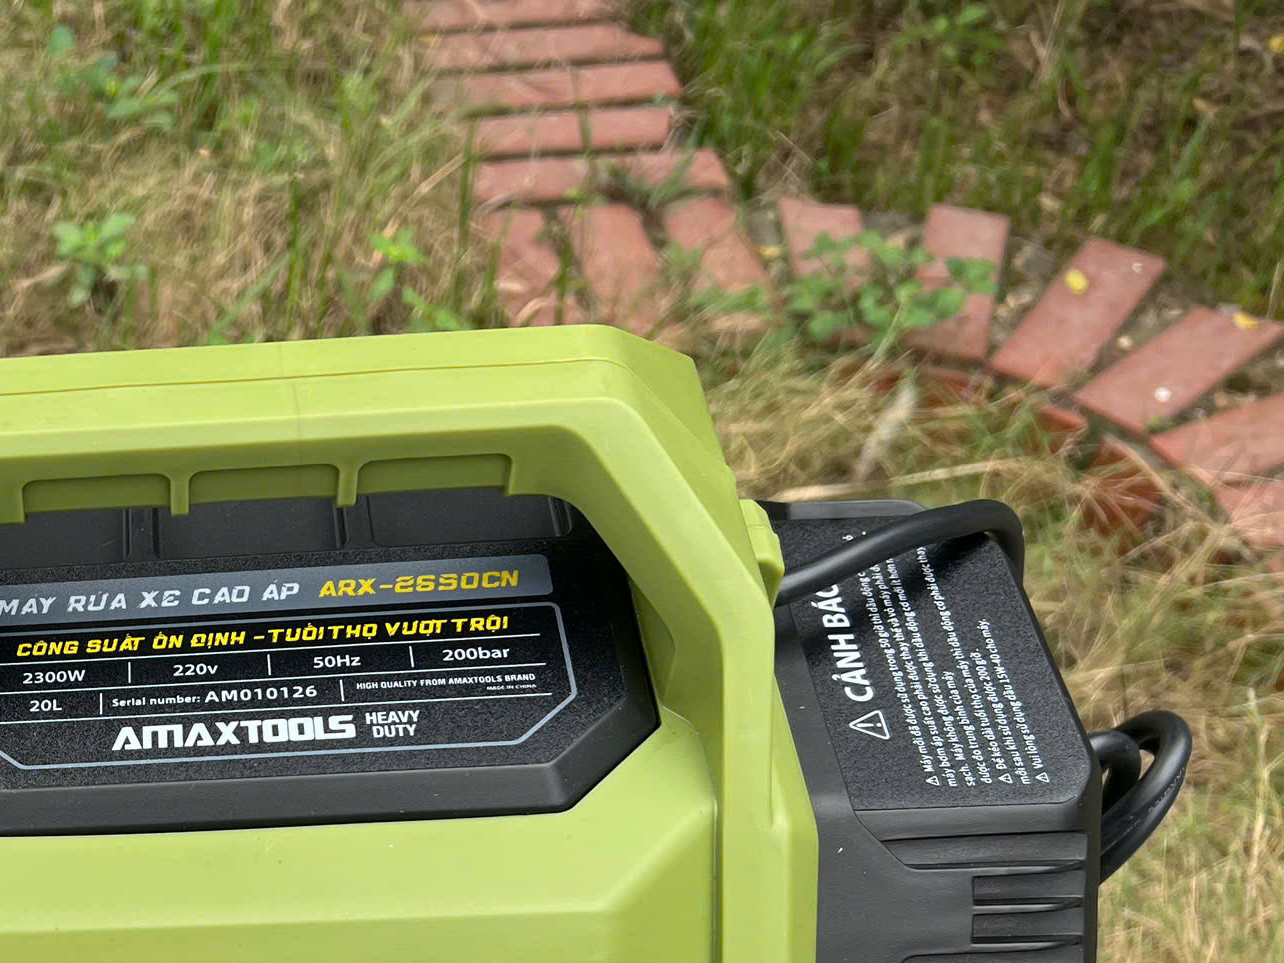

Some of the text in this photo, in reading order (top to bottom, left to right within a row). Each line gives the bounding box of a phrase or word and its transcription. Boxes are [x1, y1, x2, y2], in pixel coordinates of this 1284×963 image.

[137, 589, 181, 609] XE
[191, 585, 250, 605] CAO
[262, 579, 300, 600] ÁP
[16, 640, 79, 657] CÔNG
[190, 630, 246, 649] ĐỊNH
[327, 622, 378, 640] THỌ
[450, 614, 509, 633] TRỘI
[879, 638, 891, 648] 50
[899, 641, 912, 660] thay
[986, 638, 998, 653] cho
[313, 654, 361, 668] 50Hz
[442, 646, 510, 662] 200bar
[884, 648, 899, 671] trong
[916, 648, 929, 662] khi
[172, 663, 218, 677] 220v
[827, 634, 874, 702] CẢNH
[976, 665, 990, 681] 200
[22, 669, 86, 685] 2300W
[356, 673, 536, 690] HIGH QUALITY FROM AMAXTOOLS BRAND
[112, 685, 317, 707] Serial number: AM010126
[29, 699, 63, 712] 20L
[920, 700, 932, 716] cao
[366, 709, 420, 725] HEAVY
[112, 714, 356, 751] AMAXTOOLS
[372, 723, 417, 738] DUTY
[943, 715, 959, 742] không
[964, 724, 979, 749] trung
[988, 740, 1002, 757] kéo
[1003, 736, 1017, 750] khi
[1011, 751, 1024, 767] sau
[1029, 754, 1044, 769] Vui
[943, 768, 958, 787] máy
